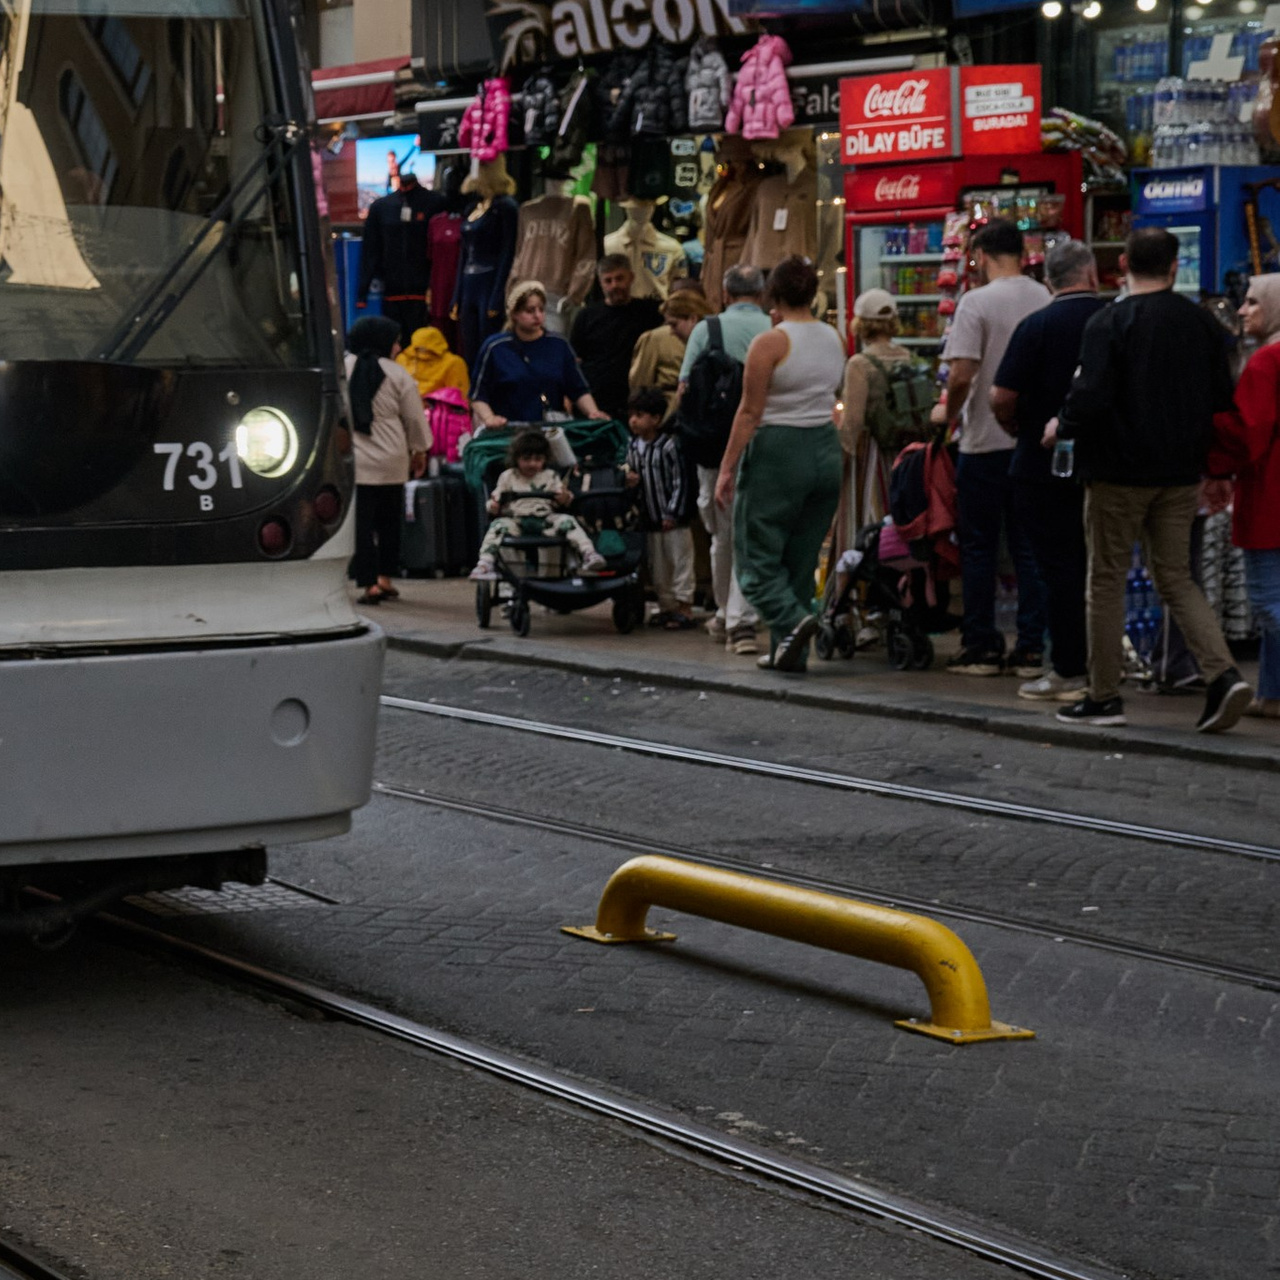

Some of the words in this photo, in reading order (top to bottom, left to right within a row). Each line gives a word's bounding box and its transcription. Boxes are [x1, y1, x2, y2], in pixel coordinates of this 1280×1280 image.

[863, 78, 930, 118] Coca-Cola
[846, 130, 895, 156] DİLAY
[897, 125, 945, 151] BÜFE
[875, 174, 920, 202] Coca-Cola
[153, 441, 243, 490] 731
[199, 494, 214, 511] B
